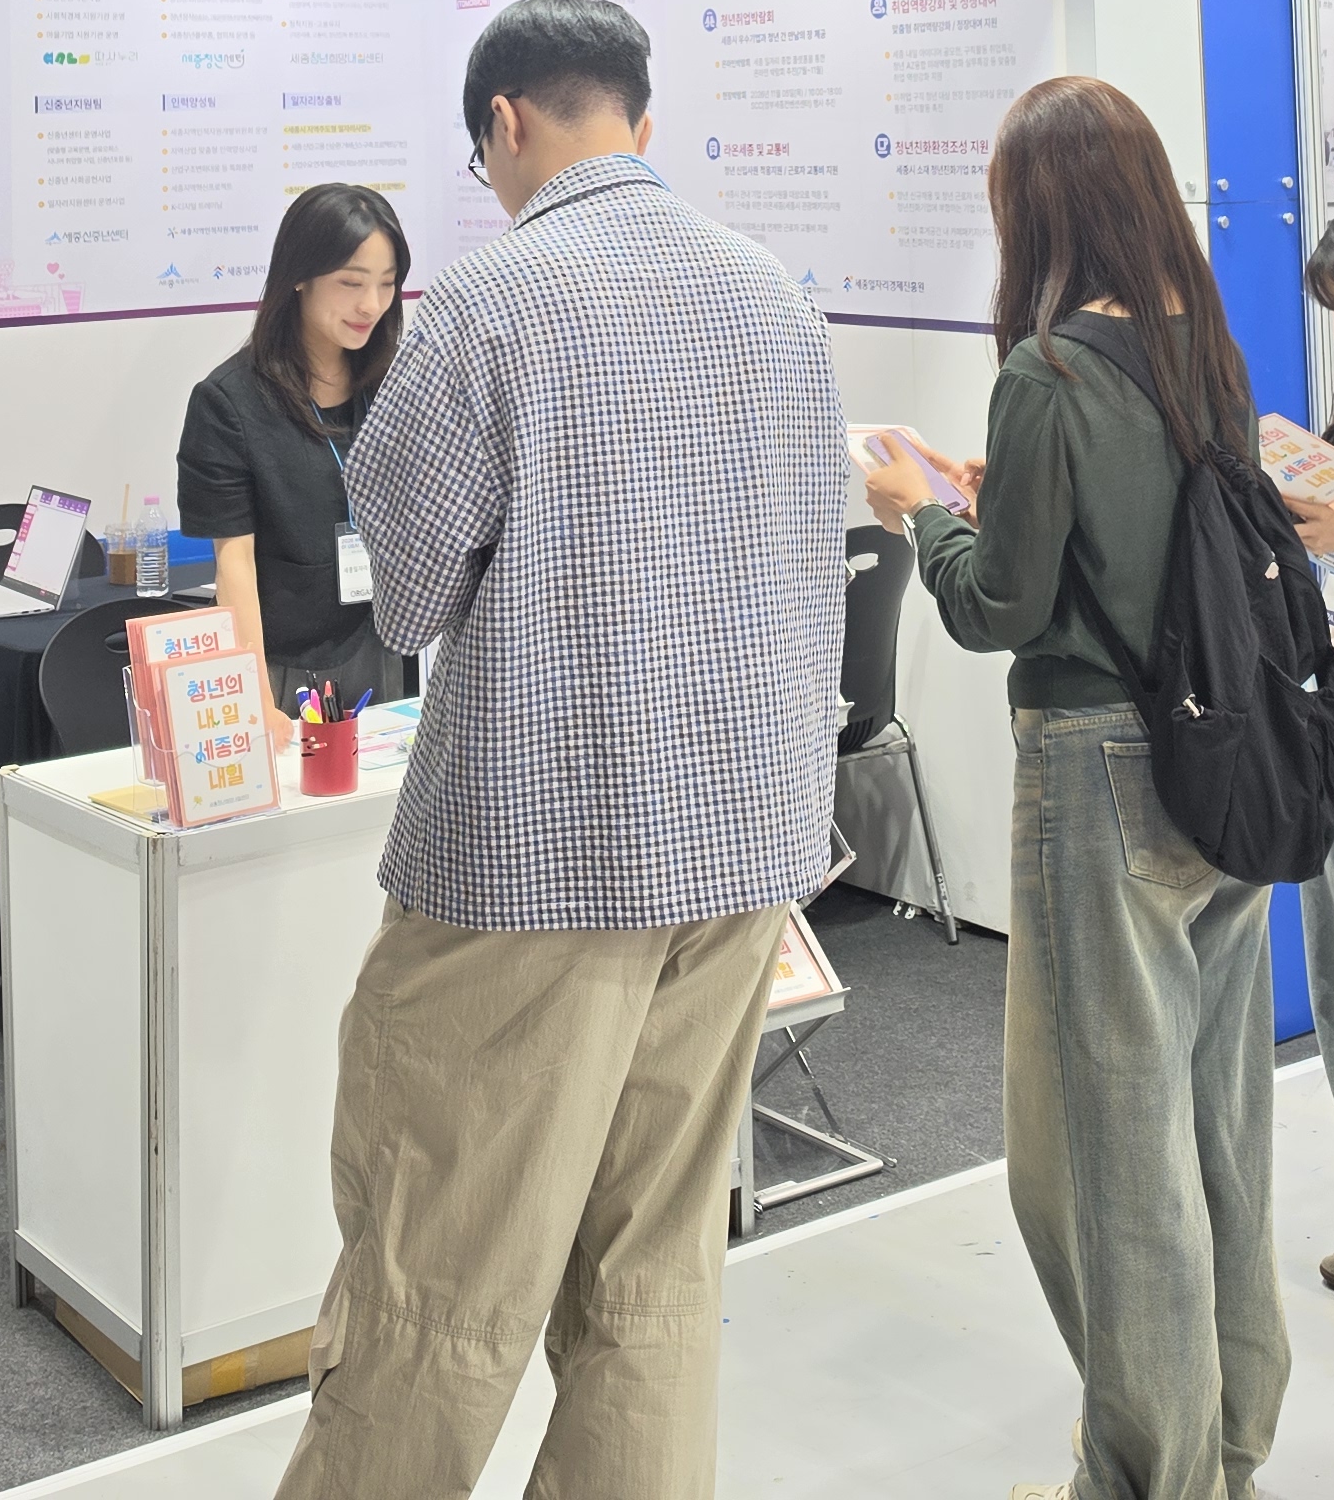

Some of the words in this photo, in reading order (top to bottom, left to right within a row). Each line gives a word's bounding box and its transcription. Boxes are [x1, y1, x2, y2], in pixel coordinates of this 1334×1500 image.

[720, 10, 774, 27] 청년취업박람회
[44, 98, 102, 111] 신중년지원팀
[724, 143, 754, 158] 라온세종
[756, 143, 764, 157] 및
[766, 142, 790, 157] 교통비
[895, 140, 968, 155] 청년친화환경조성
[970, 139, 989, 155] 지원
[855, 279, 925, 293] 세종일자리경제진흥원
[1280, 452, 1333, 482] 세종의
[164, 631, 220, 660] 청년의
[187, 673, 244, 703] 청년의
[195, 731, 251, 764] 세종의
[208, 763, 244, 790] 내일
